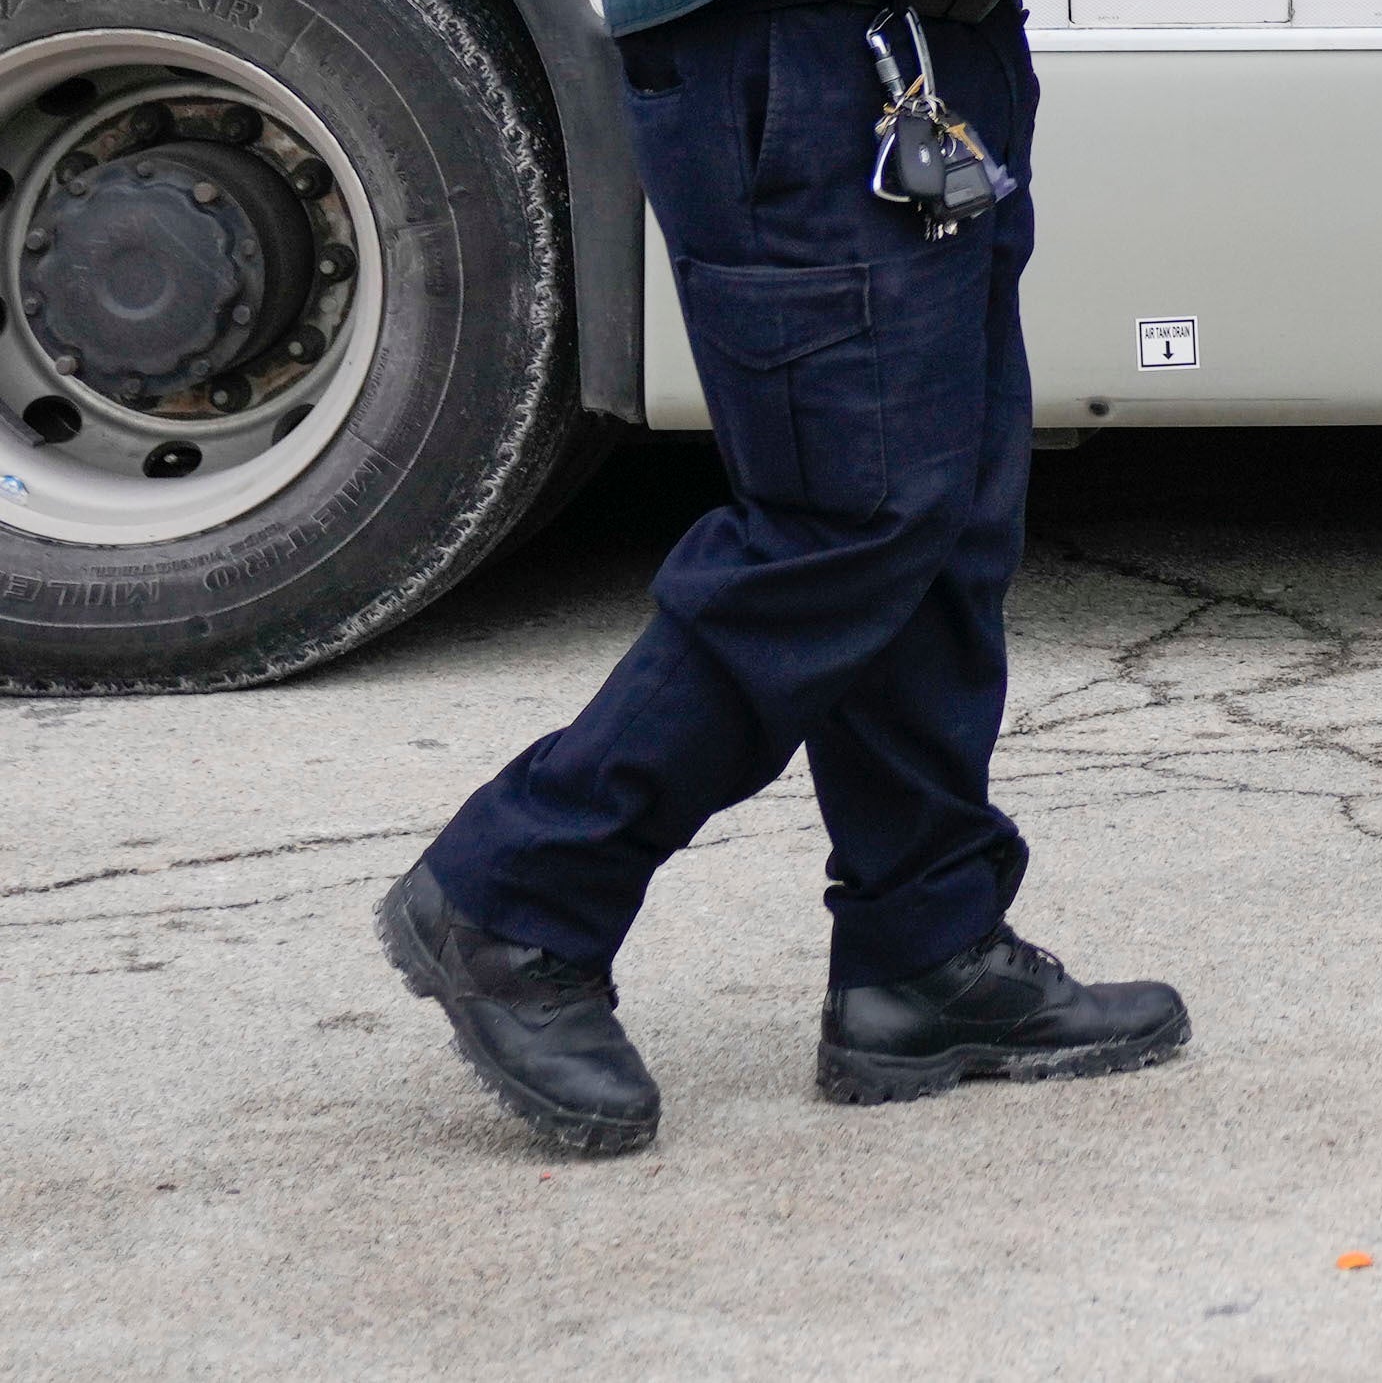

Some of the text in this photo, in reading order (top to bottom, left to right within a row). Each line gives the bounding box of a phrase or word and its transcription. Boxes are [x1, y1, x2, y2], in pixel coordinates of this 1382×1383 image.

[1145, 325, 1191, 339] AIR TANK DRAIN
